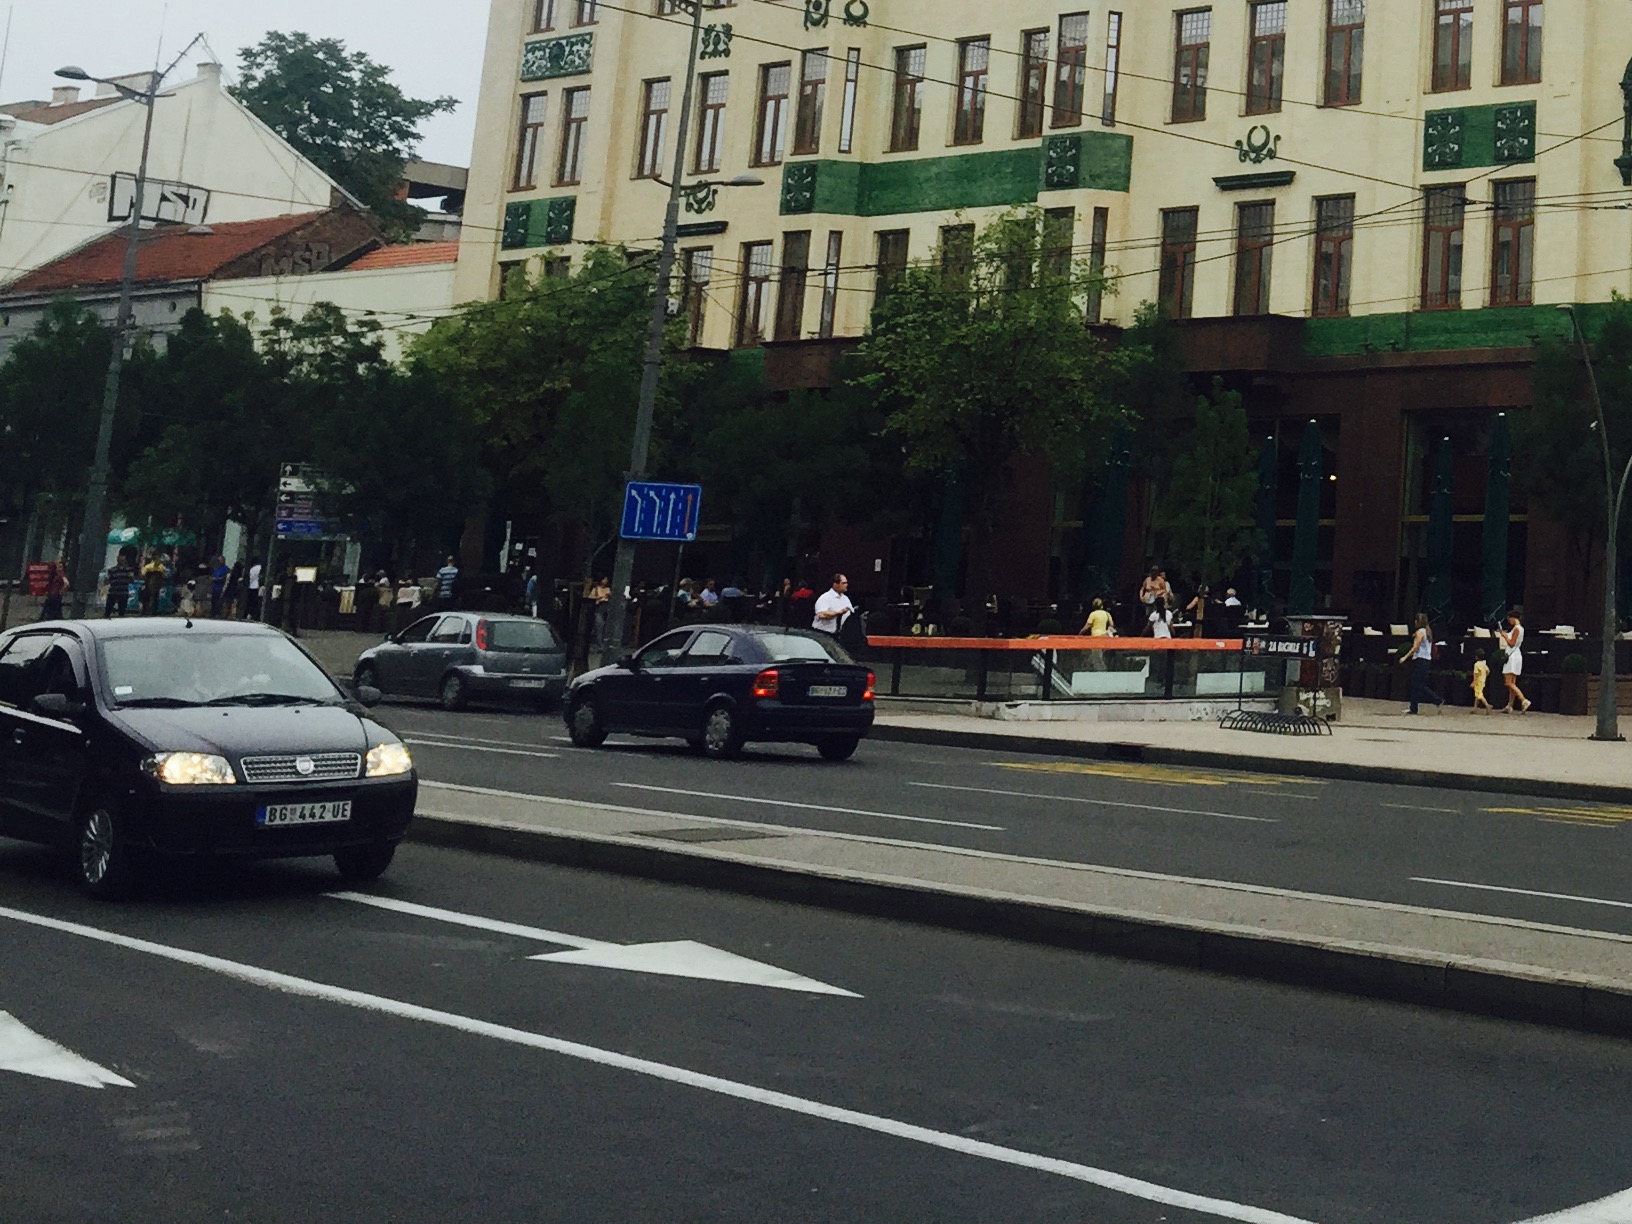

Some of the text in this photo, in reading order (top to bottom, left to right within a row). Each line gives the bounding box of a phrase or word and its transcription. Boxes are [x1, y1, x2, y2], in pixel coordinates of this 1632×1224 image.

[268, 802, 349, 822] BG 442 UE
